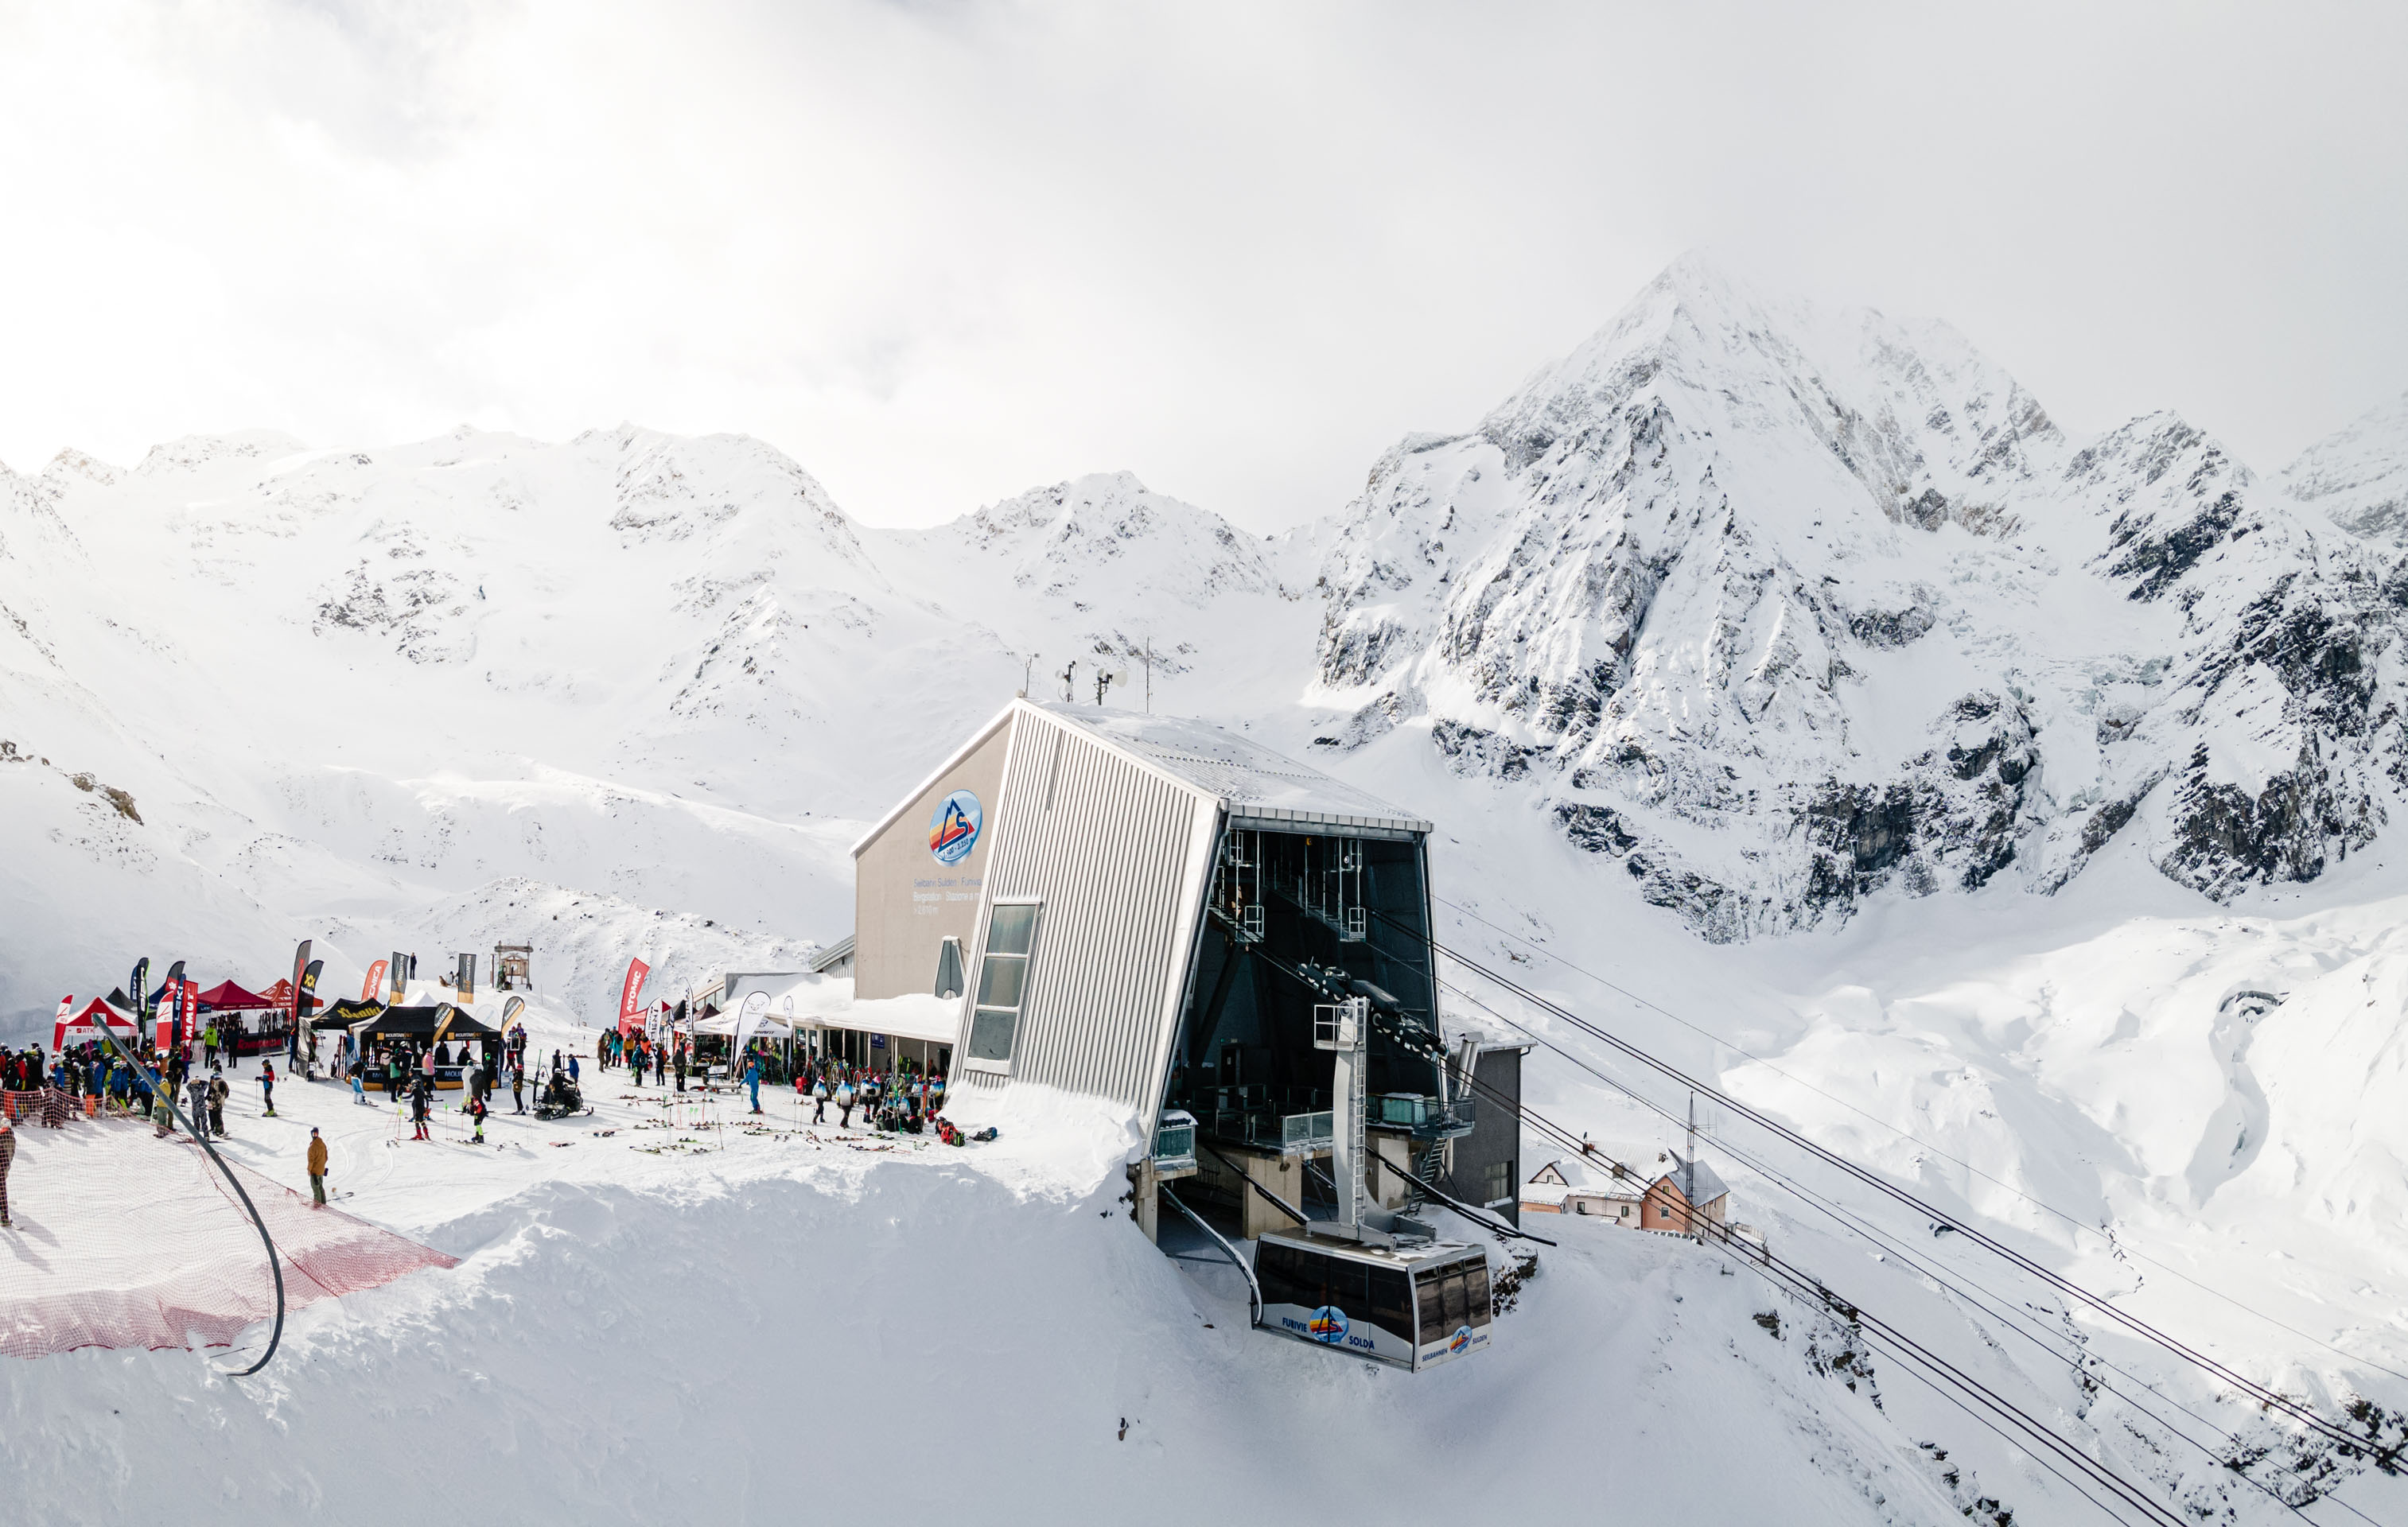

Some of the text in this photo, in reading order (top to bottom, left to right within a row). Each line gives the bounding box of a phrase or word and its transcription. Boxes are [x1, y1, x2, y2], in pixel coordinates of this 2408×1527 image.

[937, 877, 957, 888] Sulden
[368, 965, 382, 998] CNICA
[626, 970, 642, 1013] ATOMIC
[174, 985, 183, 1021] LEKI
[183, 993, 194, 1047] AMMUT
[1348, 1335, 1375, 1350] SOLDA
[1422, 1334, 1488, 1362] SEILBAHNEN SULDEN
